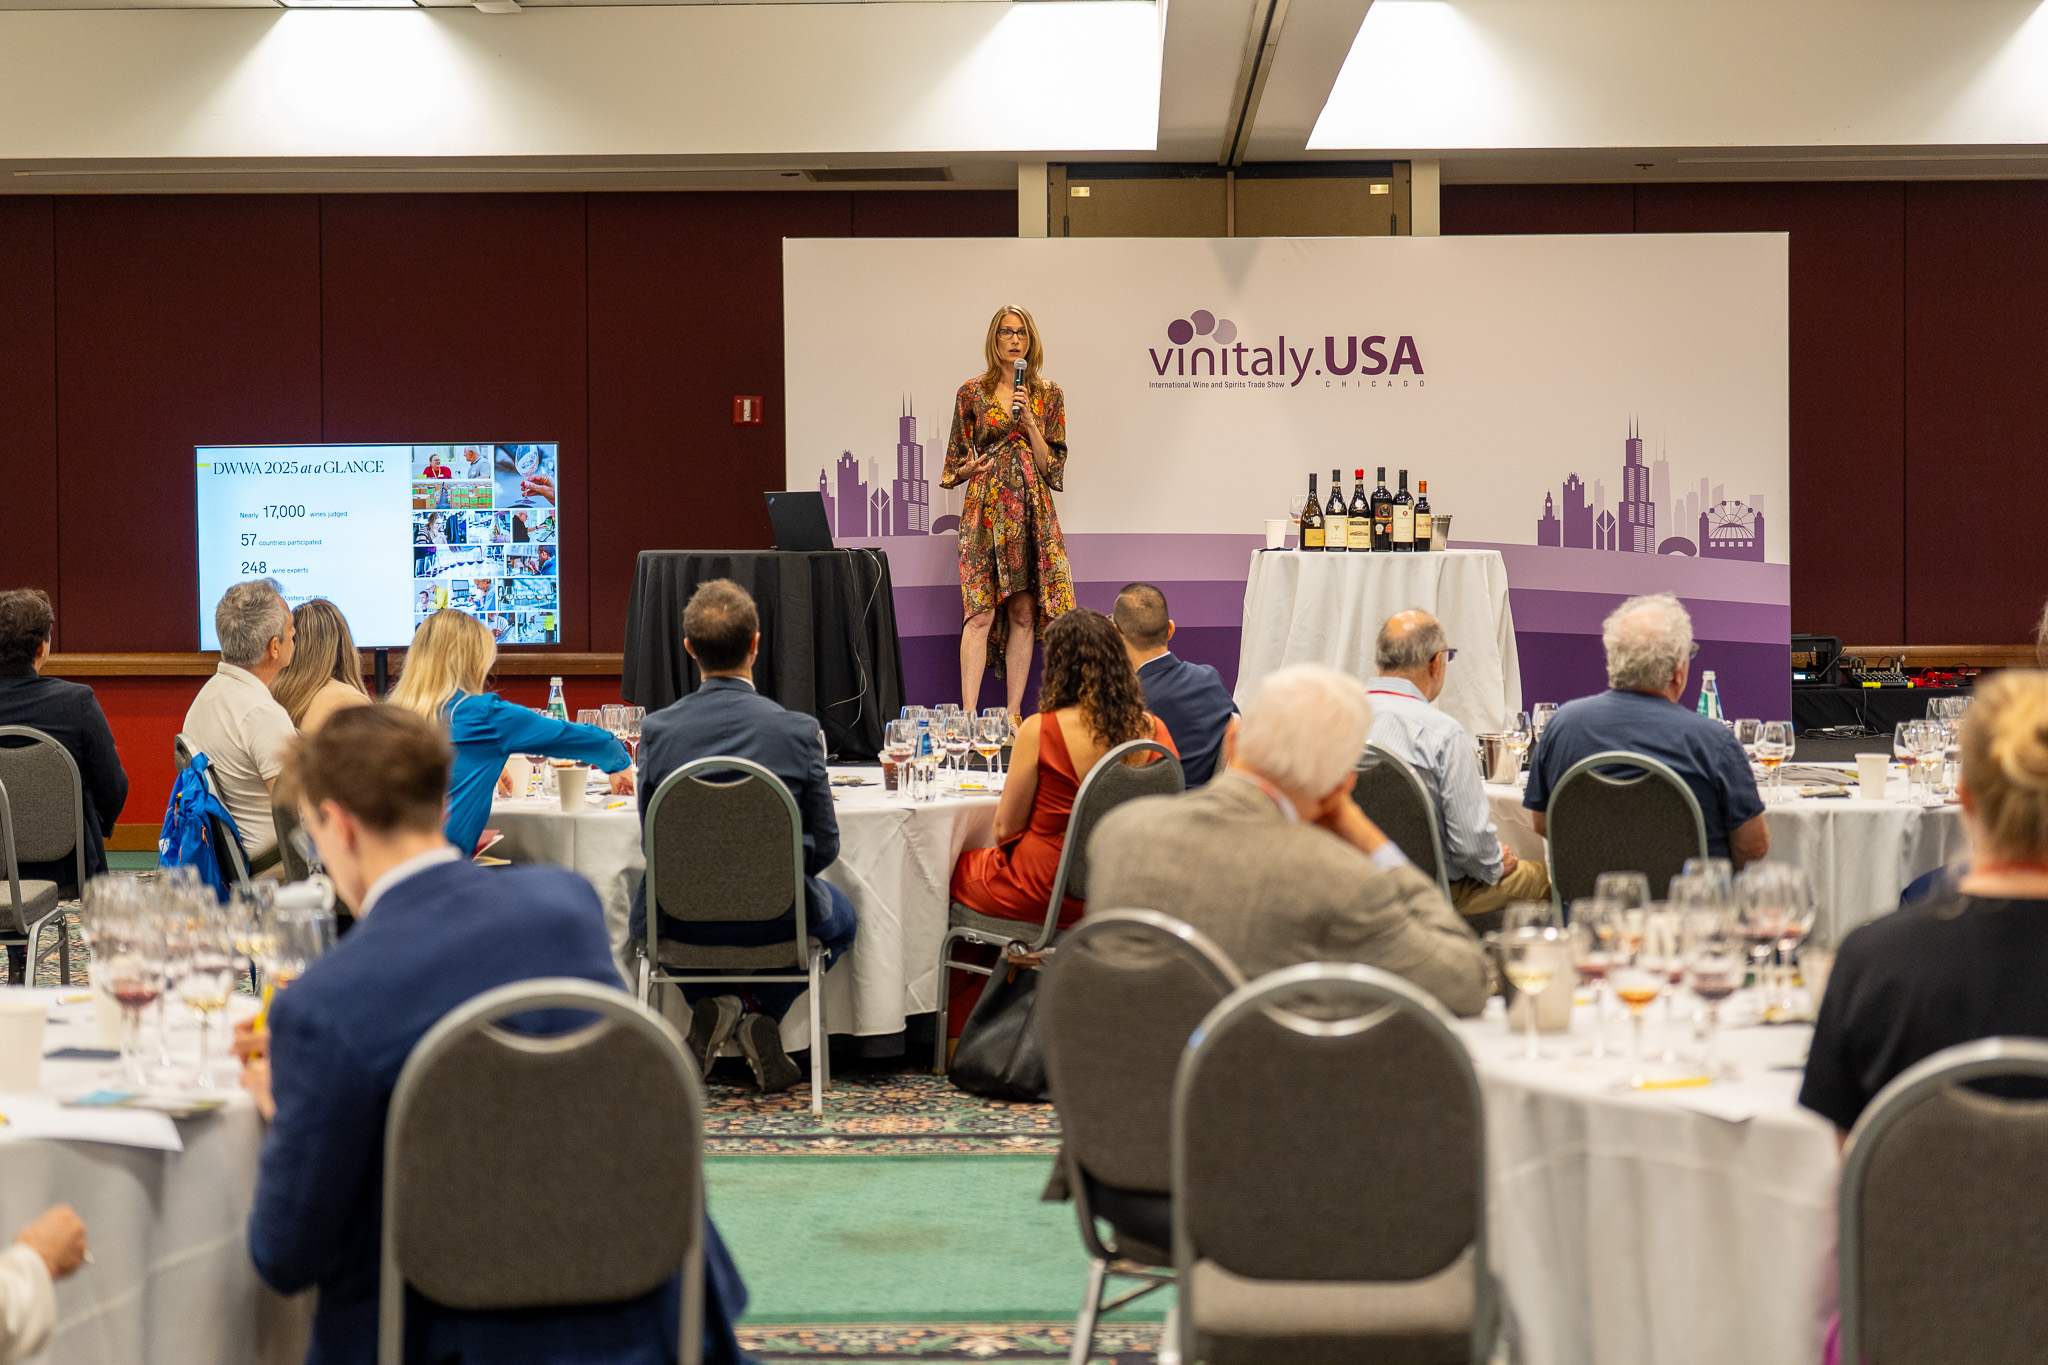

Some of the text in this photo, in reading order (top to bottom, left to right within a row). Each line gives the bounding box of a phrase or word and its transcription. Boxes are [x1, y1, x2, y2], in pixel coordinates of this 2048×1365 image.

[1149, 335, 1424, 388] vinitaly.USA
[1224, 381, 1246, 389] Spirits
[213, 460, 385, 475] DWWA 2025 at a GLANCE
[239, 512, 259, 520] Nearly
[263, 504, 306, 520] 17,000
[327, 511, 348, 519] judged
[241, 533, 257, 547] 57
[287, 539, 322, 547] participated
[241, 560, 267, 574] 248
[286, 567, 309, 575] experts
